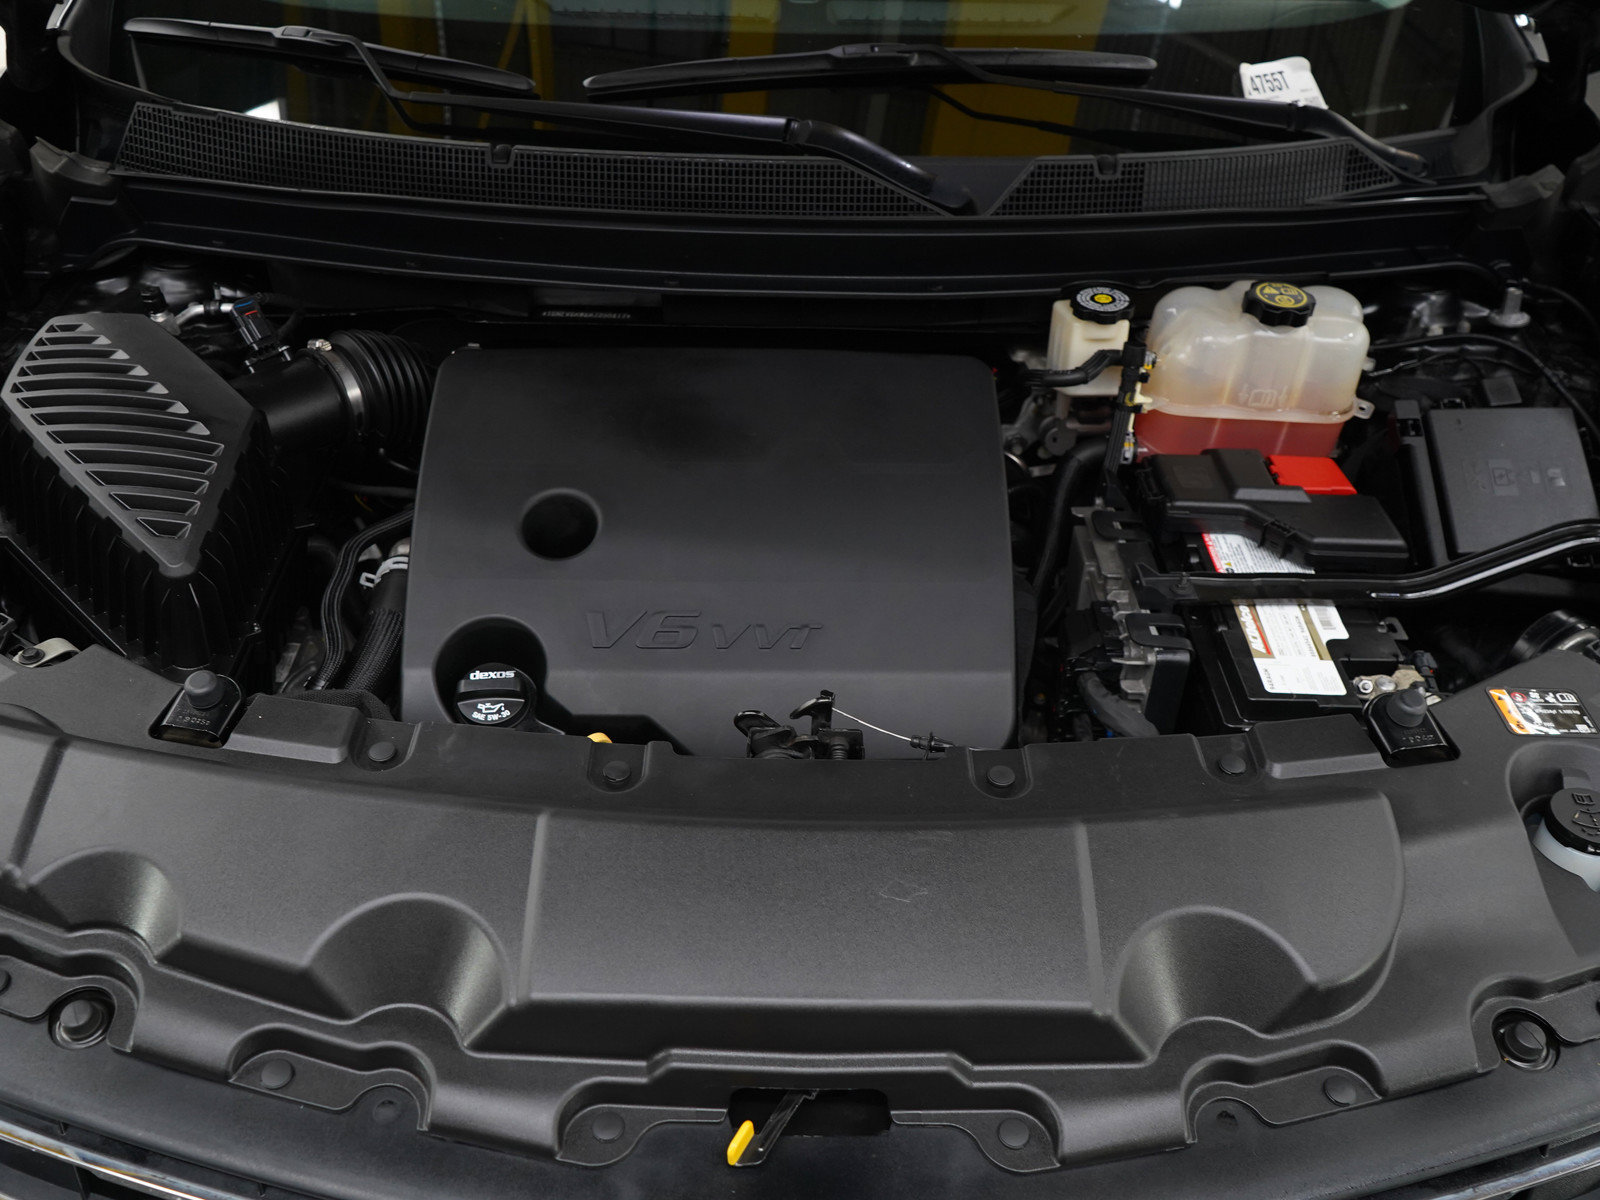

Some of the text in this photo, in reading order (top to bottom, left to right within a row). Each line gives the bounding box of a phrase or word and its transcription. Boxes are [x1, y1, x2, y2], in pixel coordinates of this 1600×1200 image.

[1248, 71, 1289, 95] 4755T
[585, 610, 824, 650] V6 VVT
[1238, 604, 1267, 655] ACDelco
[469, 670, 517, 680] dexos
[471, 709, 511, 721] SAE 5W-30
